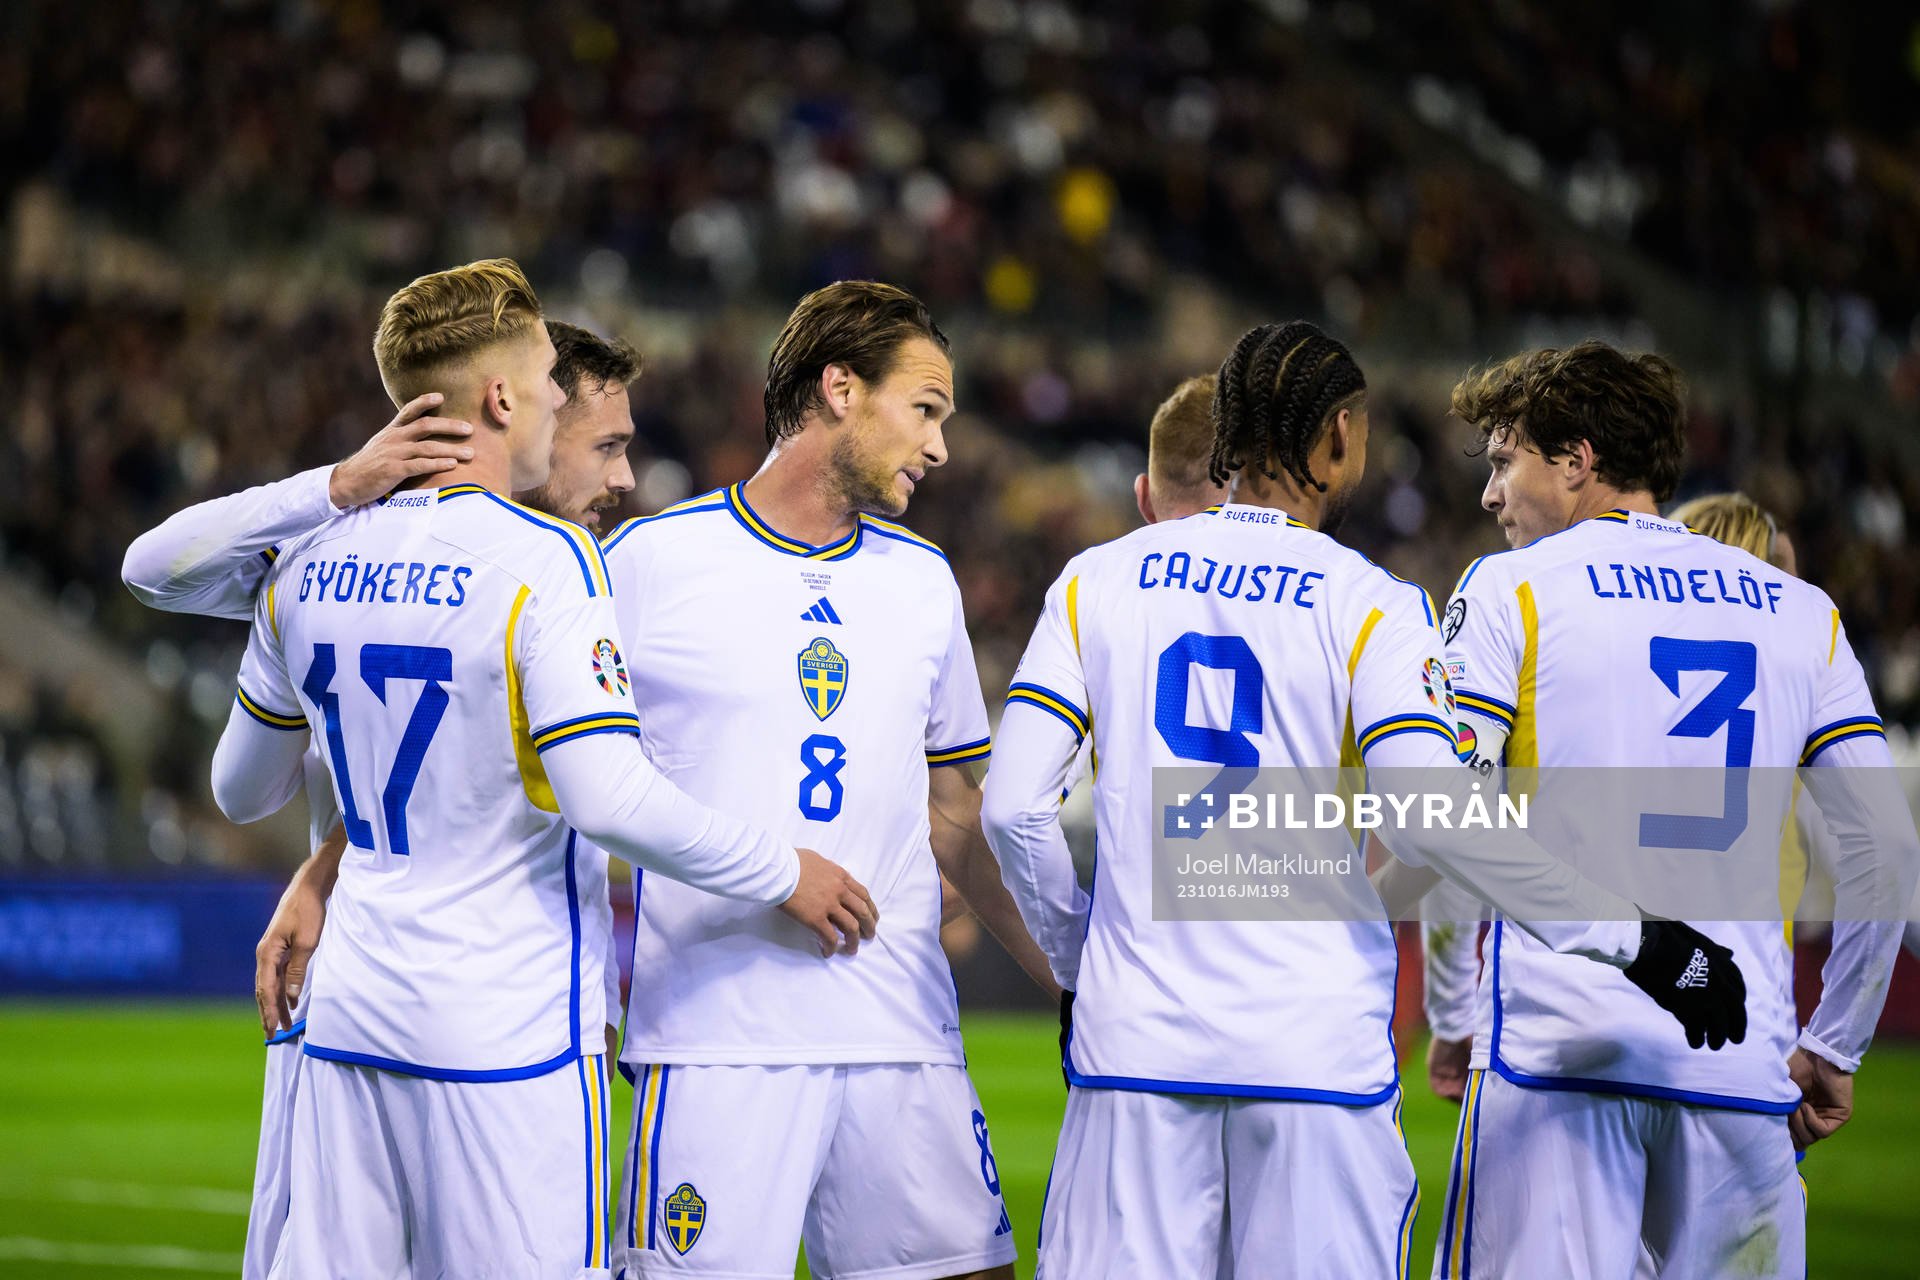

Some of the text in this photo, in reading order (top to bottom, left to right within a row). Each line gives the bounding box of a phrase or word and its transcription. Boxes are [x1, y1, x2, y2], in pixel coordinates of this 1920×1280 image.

[387, 495, 430, 508] SVERIGE
[1224, 510, 1279, 525] SVERIGE
[298, 553, 473, 608] GYÖKERES
[1138, 551, 1325, 609] CAJUSTE
[1586, 563, 1783, 615] LINDELÖF
[806, 660, 839, 670] SVERIGE
[300, 642, 453, 857] 17
[1155, 631, 1264, 840] 9
[1639, 635, 1758, 853] 3
[798, 733, 847, 823] 8
[1675, 947, 1704, 989] adidas
[971, 1108, 1001, 1197] 8
